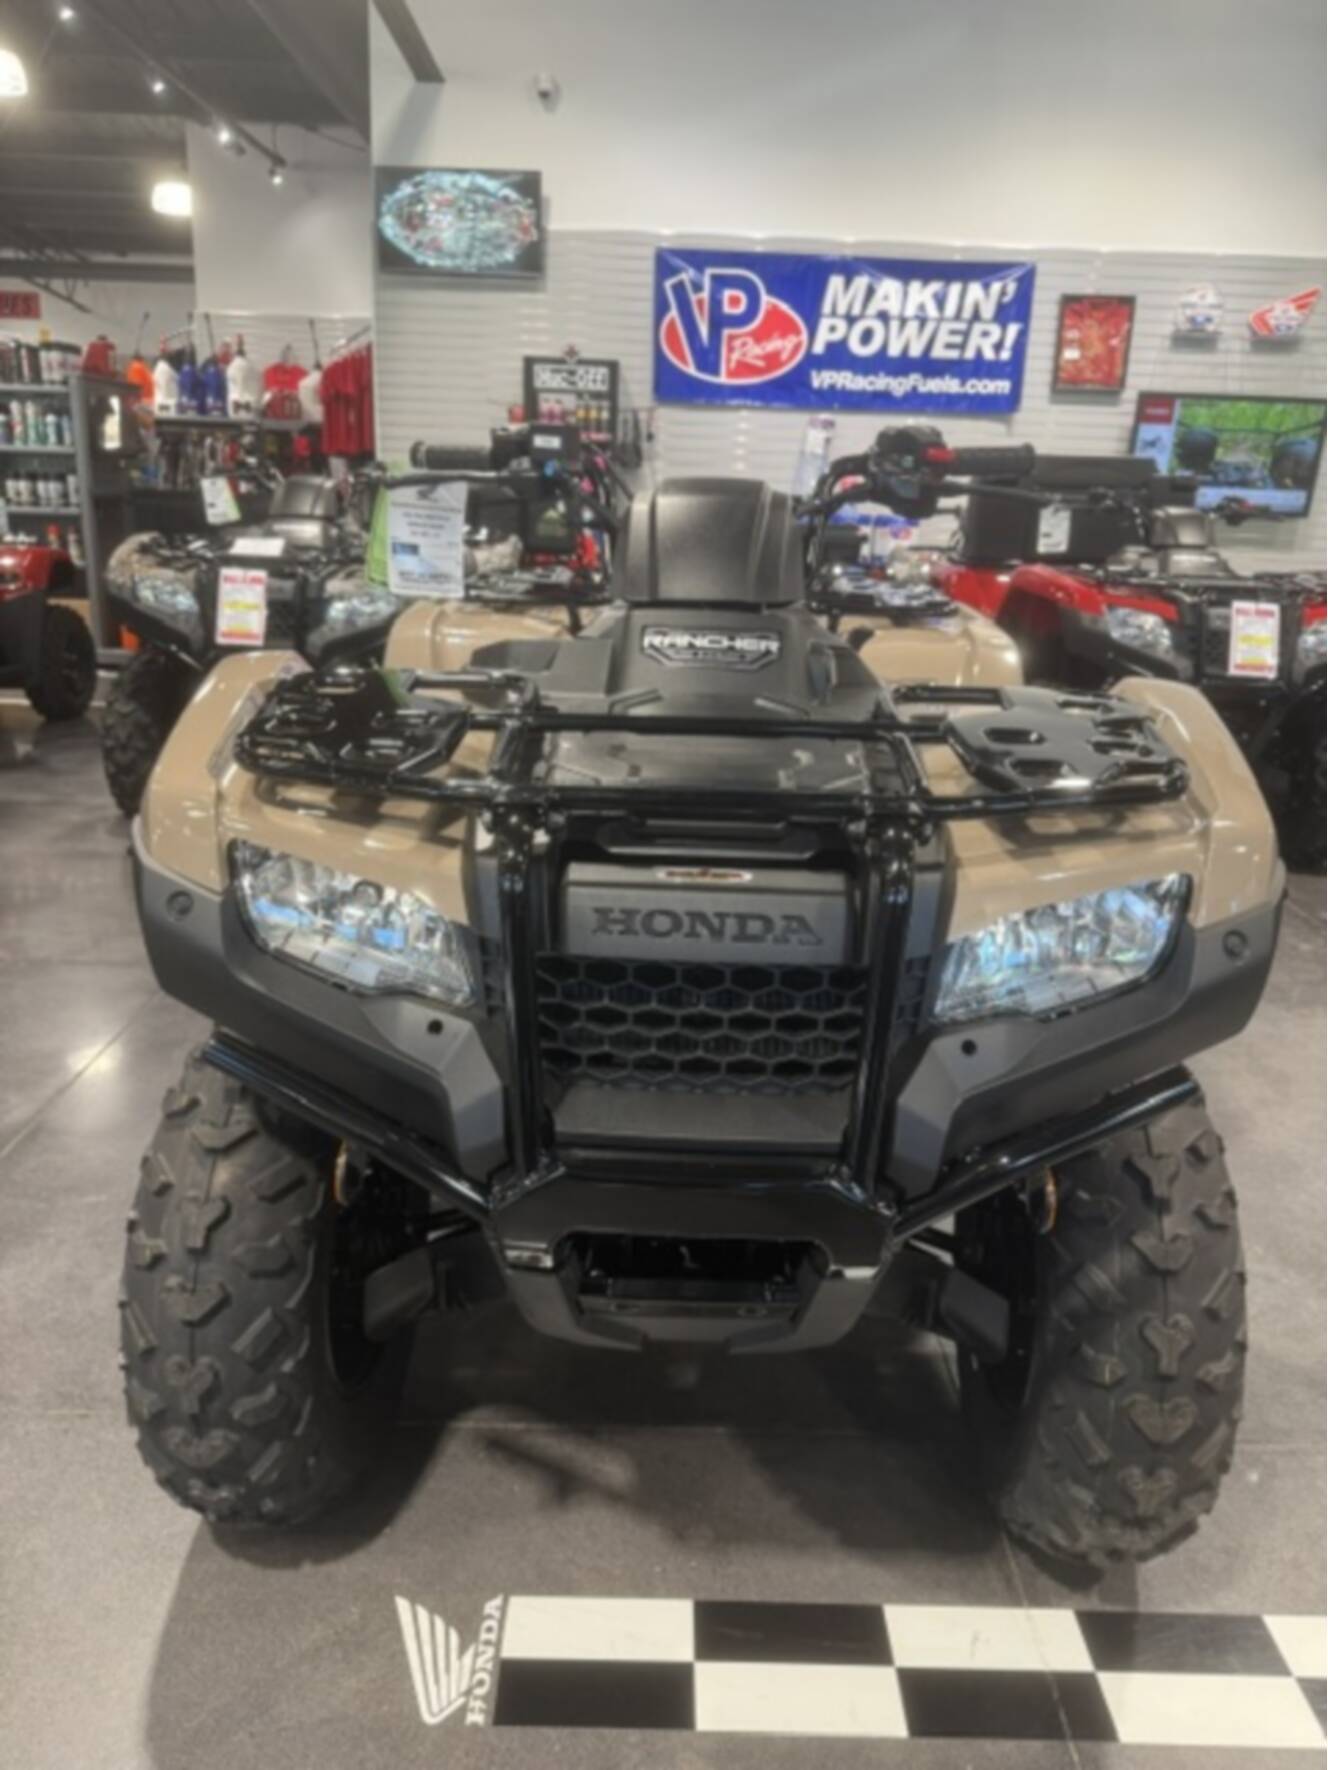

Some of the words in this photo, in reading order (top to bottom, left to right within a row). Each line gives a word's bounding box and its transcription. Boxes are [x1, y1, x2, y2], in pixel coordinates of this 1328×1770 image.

[822, 274, 1018, 321] MAKIN'
[664, 267, 767, 384] VP
[811, 317, 1024, 361] POWER!
[730, 332, 804, 371] Racing
[810, 370, 1012, 397] VPRacingFuels.com
[643, 632, 780, 653] RANCHER
[591, 906, 824, 947] HONDA
[465, 1593, 504, 1727] HONDA
